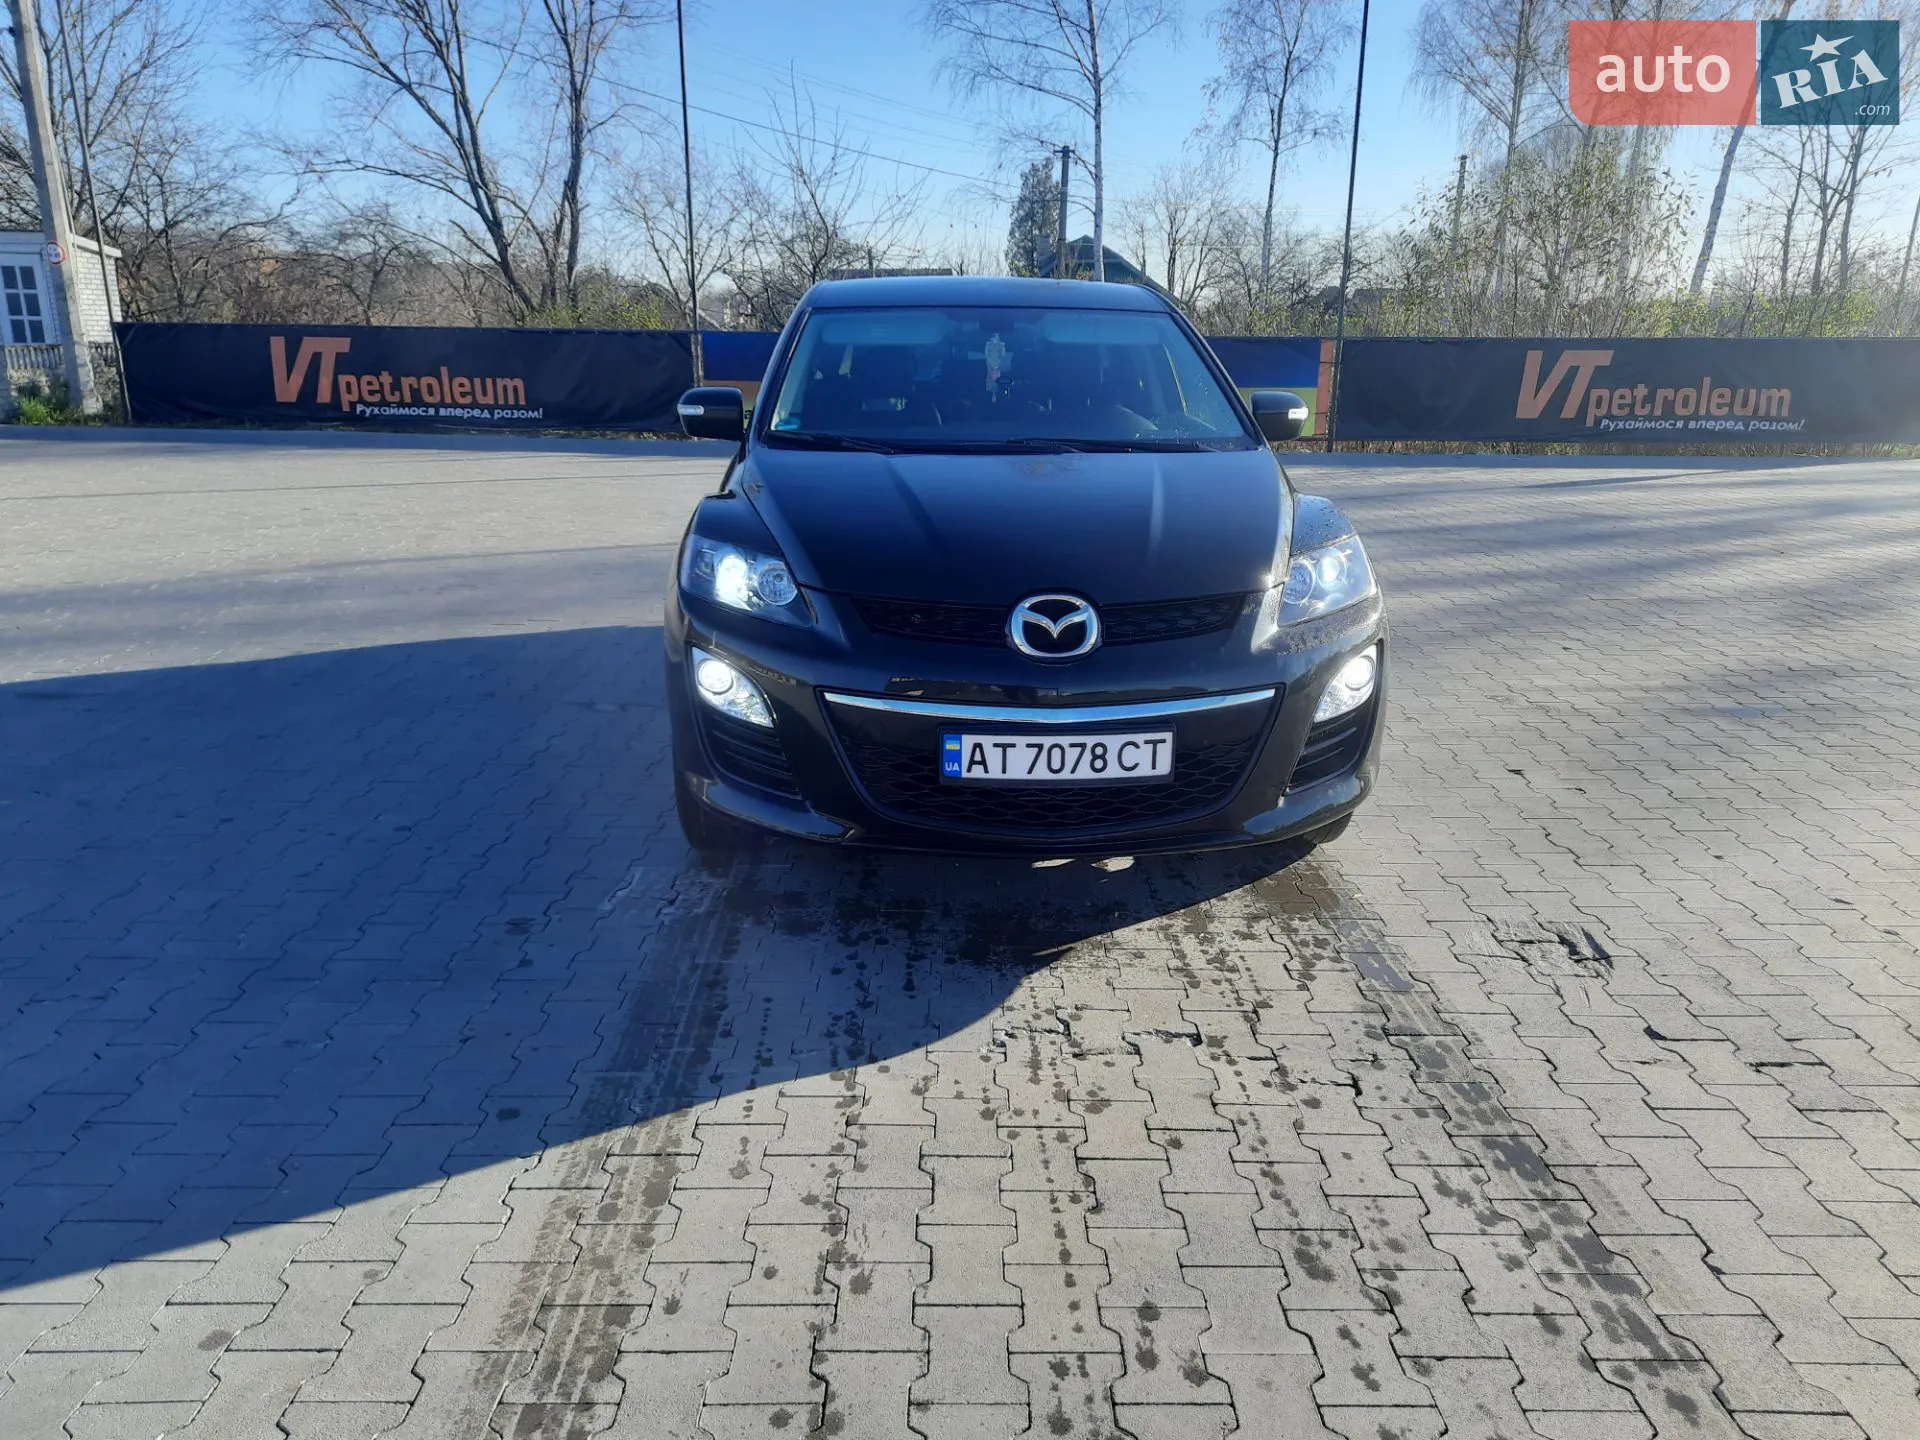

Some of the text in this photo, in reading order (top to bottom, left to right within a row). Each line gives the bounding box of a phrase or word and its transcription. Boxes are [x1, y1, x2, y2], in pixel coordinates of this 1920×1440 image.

[356, 403, 544, 420] Рухаймося вперед разом!
[1600, 417, 1805, 432] Рухаймося вперед разом!
[945, 761, 960, 772] UA
